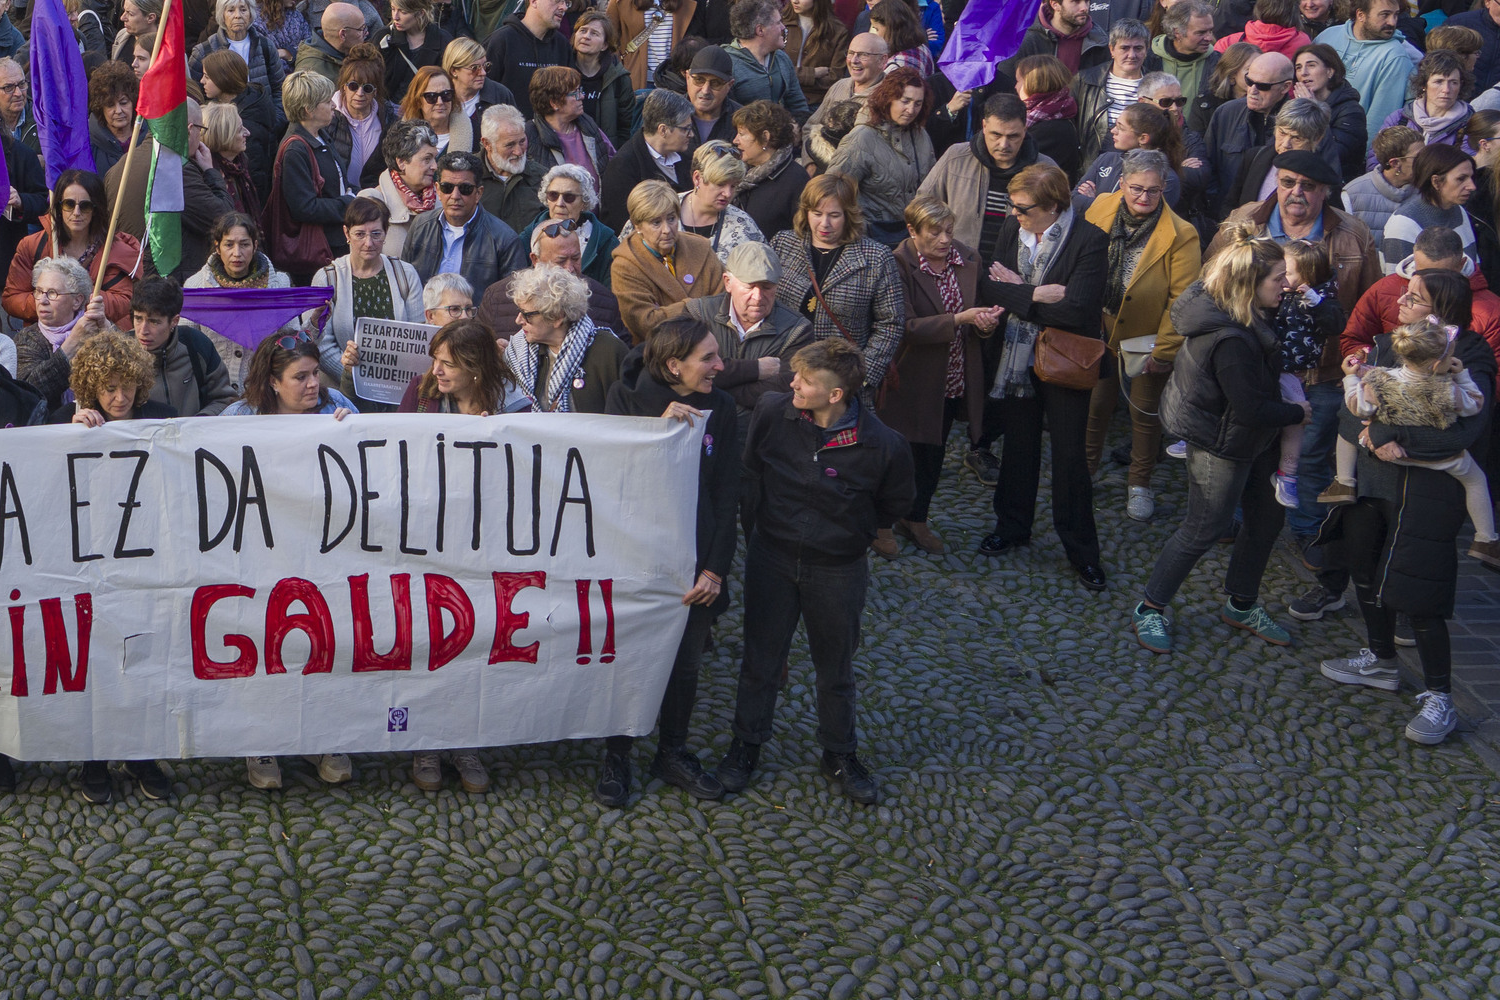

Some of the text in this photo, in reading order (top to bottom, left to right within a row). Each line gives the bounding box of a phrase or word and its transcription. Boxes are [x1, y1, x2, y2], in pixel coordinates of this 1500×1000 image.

[362, 323, 428, 341] ELKARTASUNA
[361, 337, 427, 355] EZ DA DELITUA
[360, 350, 398, 366] ZUEKIN
[66, 448, 155, 563] EZ
[195, 445, 275, 554] DA
[189, 570, 548, 681] GAUDE
